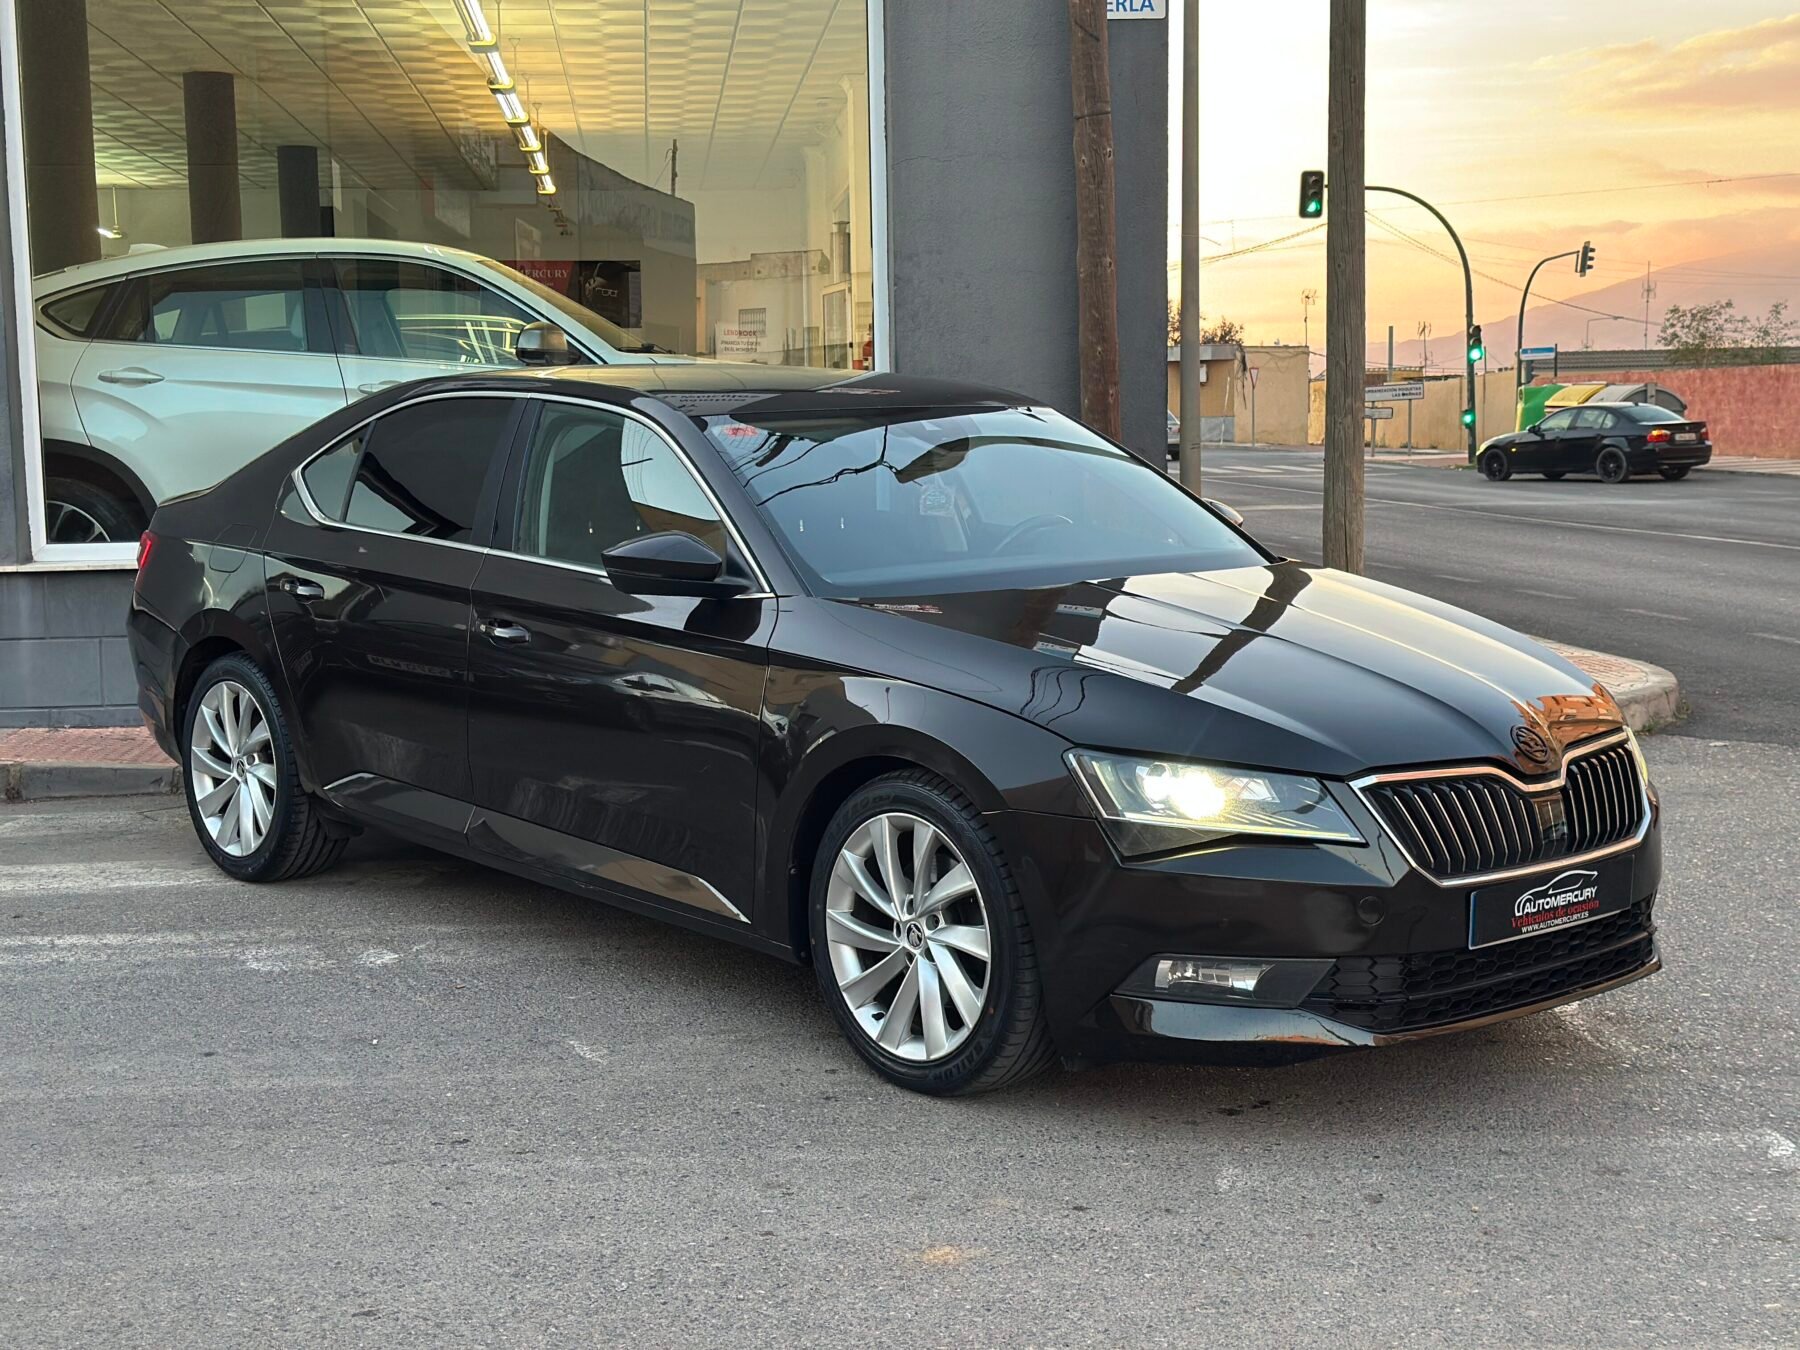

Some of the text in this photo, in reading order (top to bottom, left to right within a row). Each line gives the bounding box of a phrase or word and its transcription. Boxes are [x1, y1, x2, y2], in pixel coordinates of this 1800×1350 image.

[1523, 886, 1598, 915] AUTOMERCURY
[1555, 906, 1566, 917] de
[1521, 911, 1589, 934] WWW.AUTOMERCURY.ES
